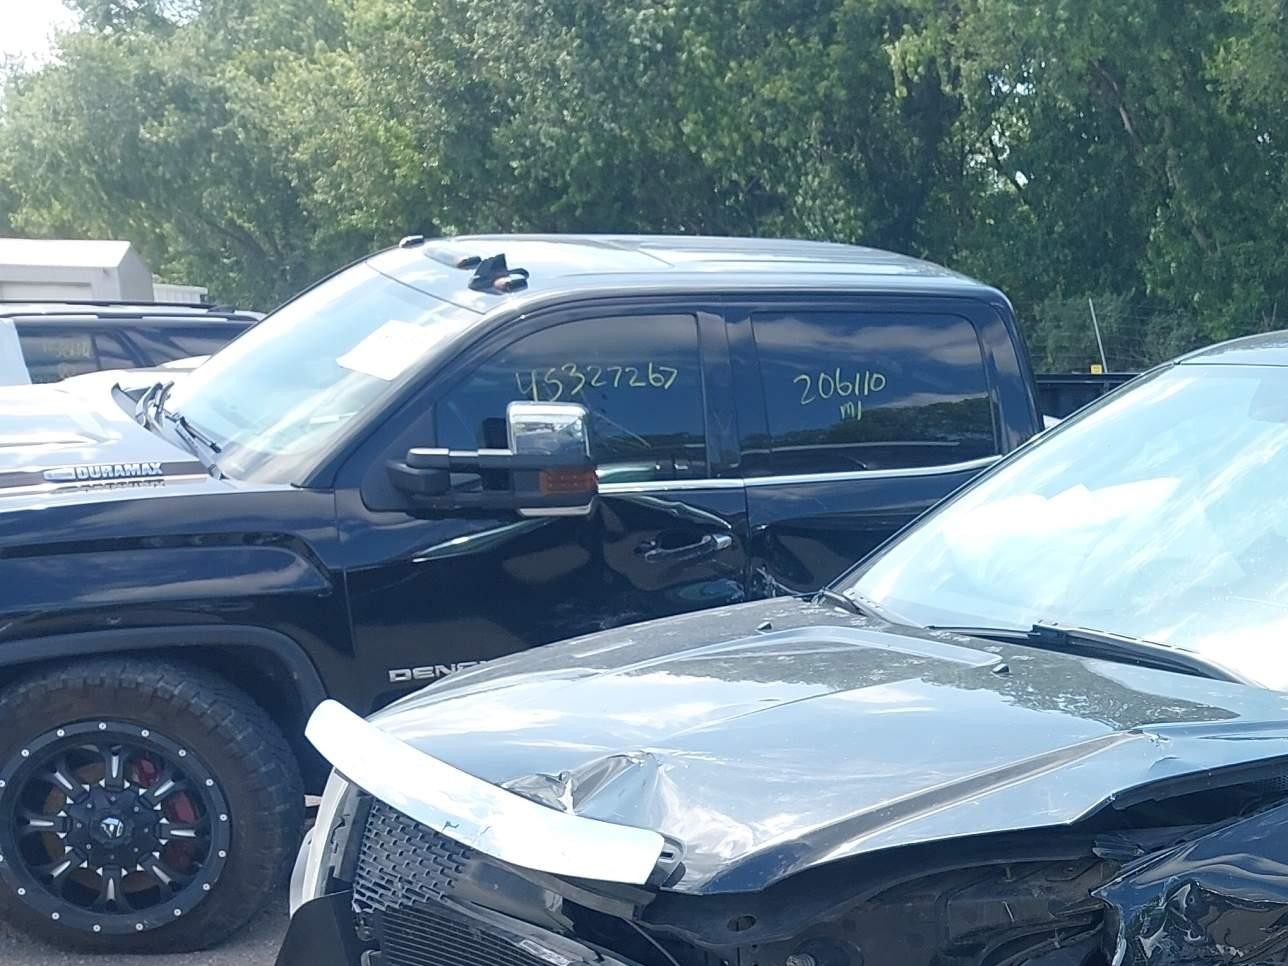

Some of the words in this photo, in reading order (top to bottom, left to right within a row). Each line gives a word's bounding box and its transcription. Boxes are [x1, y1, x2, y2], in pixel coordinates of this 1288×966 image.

[516, 362, 678, 401] 45327267
[793, 367, 886, 404] 206110
[76, 462, 162, 480] DURAMAX
